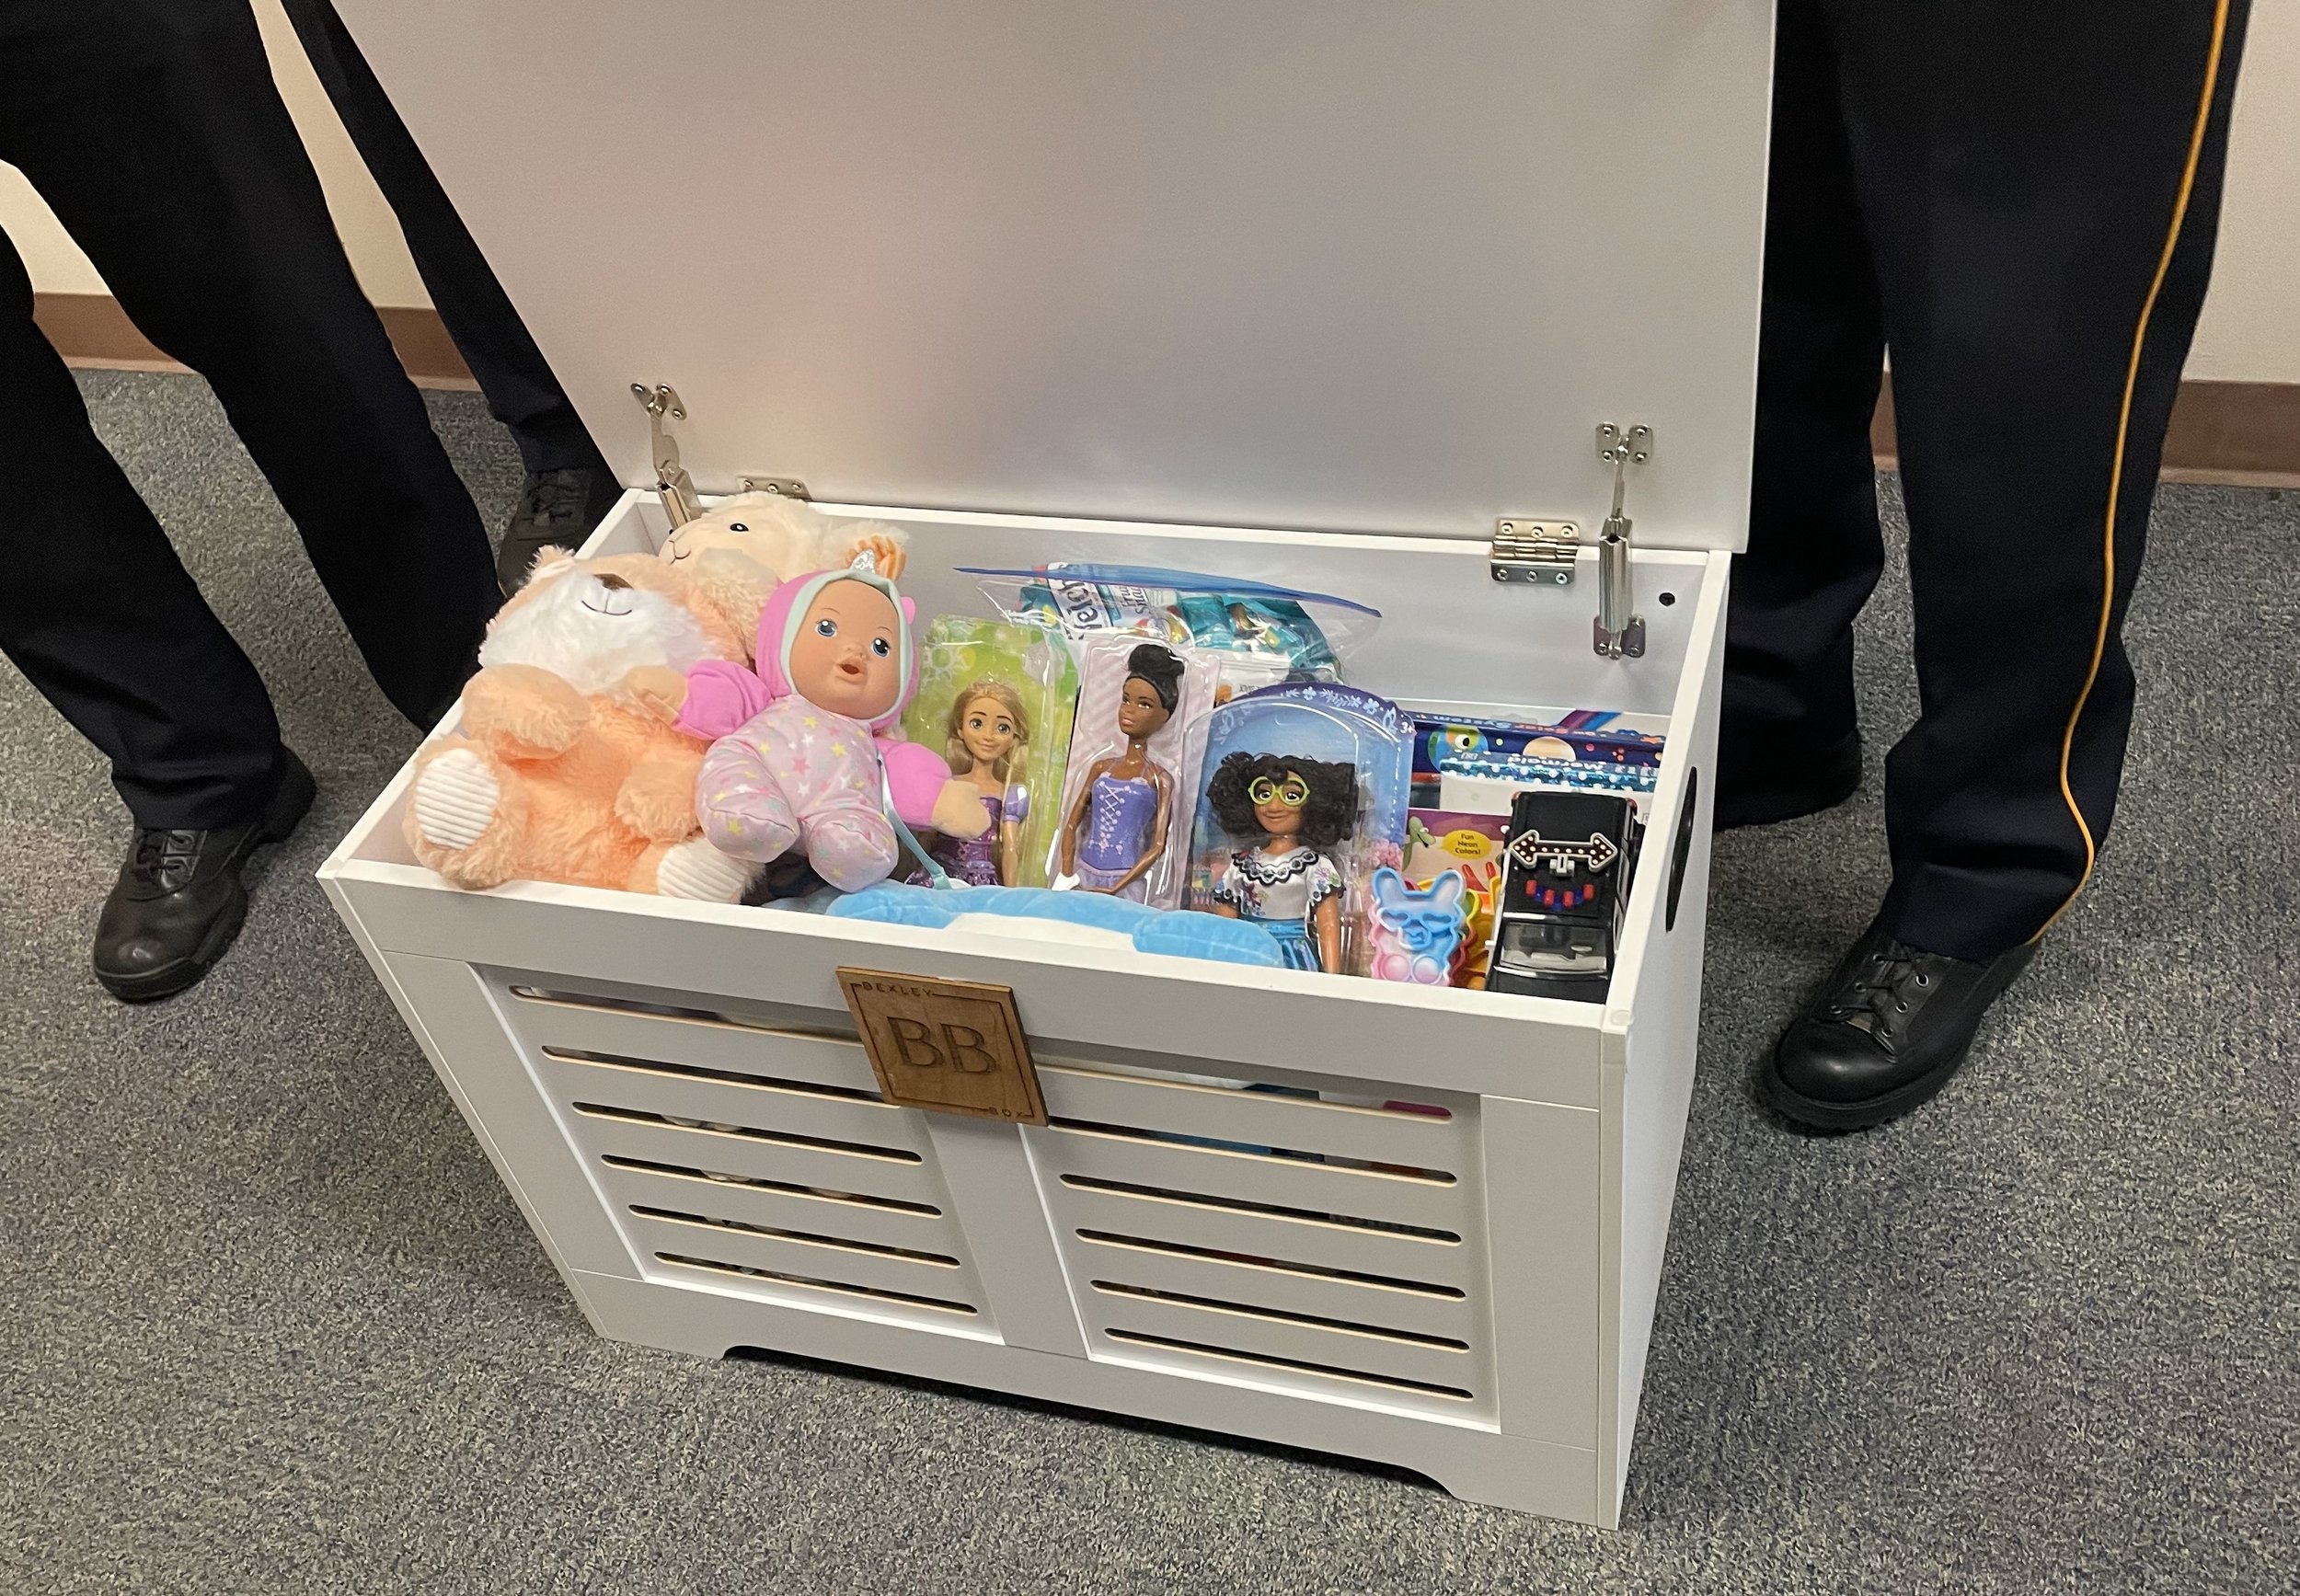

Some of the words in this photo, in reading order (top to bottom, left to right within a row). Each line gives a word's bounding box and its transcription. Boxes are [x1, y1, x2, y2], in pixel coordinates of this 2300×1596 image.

[1432, 715, 1512, 729] System
[1513, 723, 1569, 735] Solar
[1507, 756, 1604, 770] Mermaid
[1457, 840, 1478, 848] Neon
[861, 982, 931, 997] BEXLEY
[886, 1016, 997, 1074] BB
